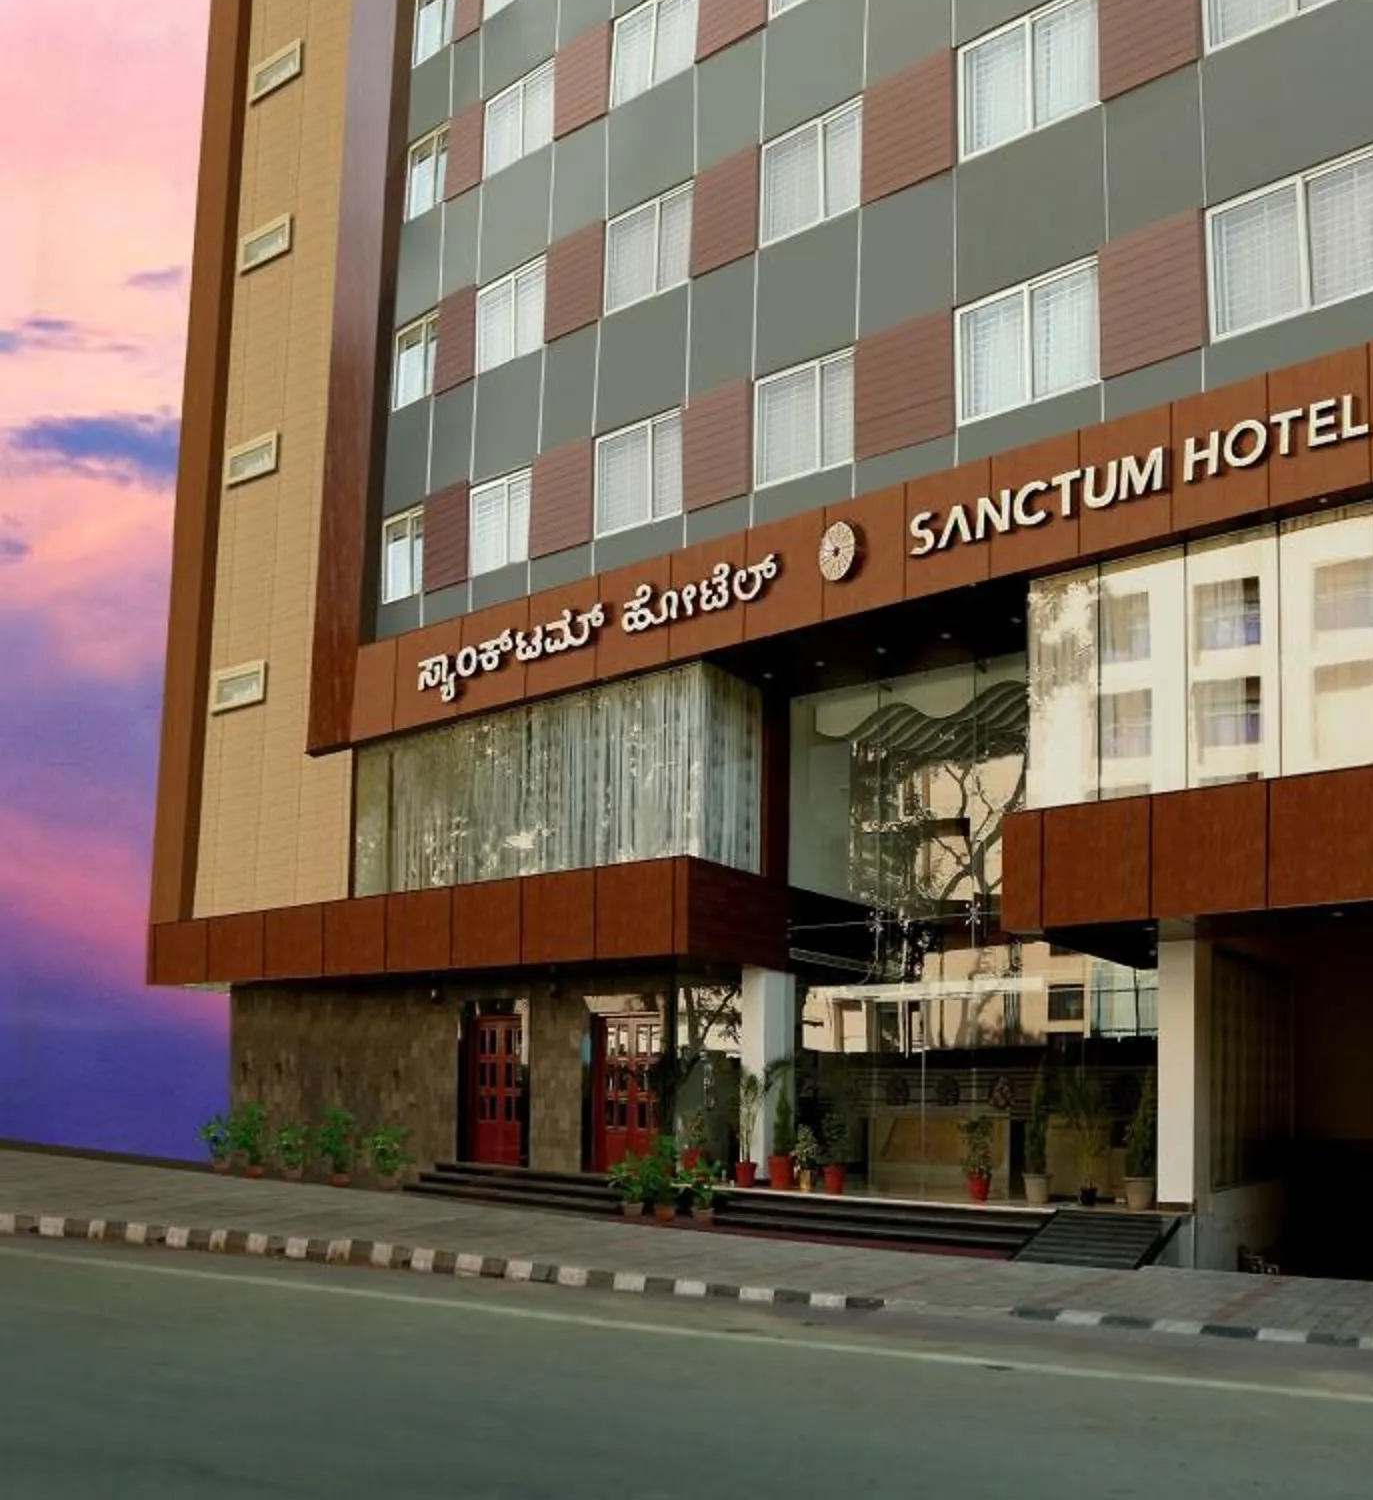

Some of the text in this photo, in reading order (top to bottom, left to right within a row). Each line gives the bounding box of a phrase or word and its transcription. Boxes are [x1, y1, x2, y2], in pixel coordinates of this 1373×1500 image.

[908, 393, 1370, 556] SANCTUM HOTEL
[621, 553, 778, 633] ಹೋಟೆಲ್
